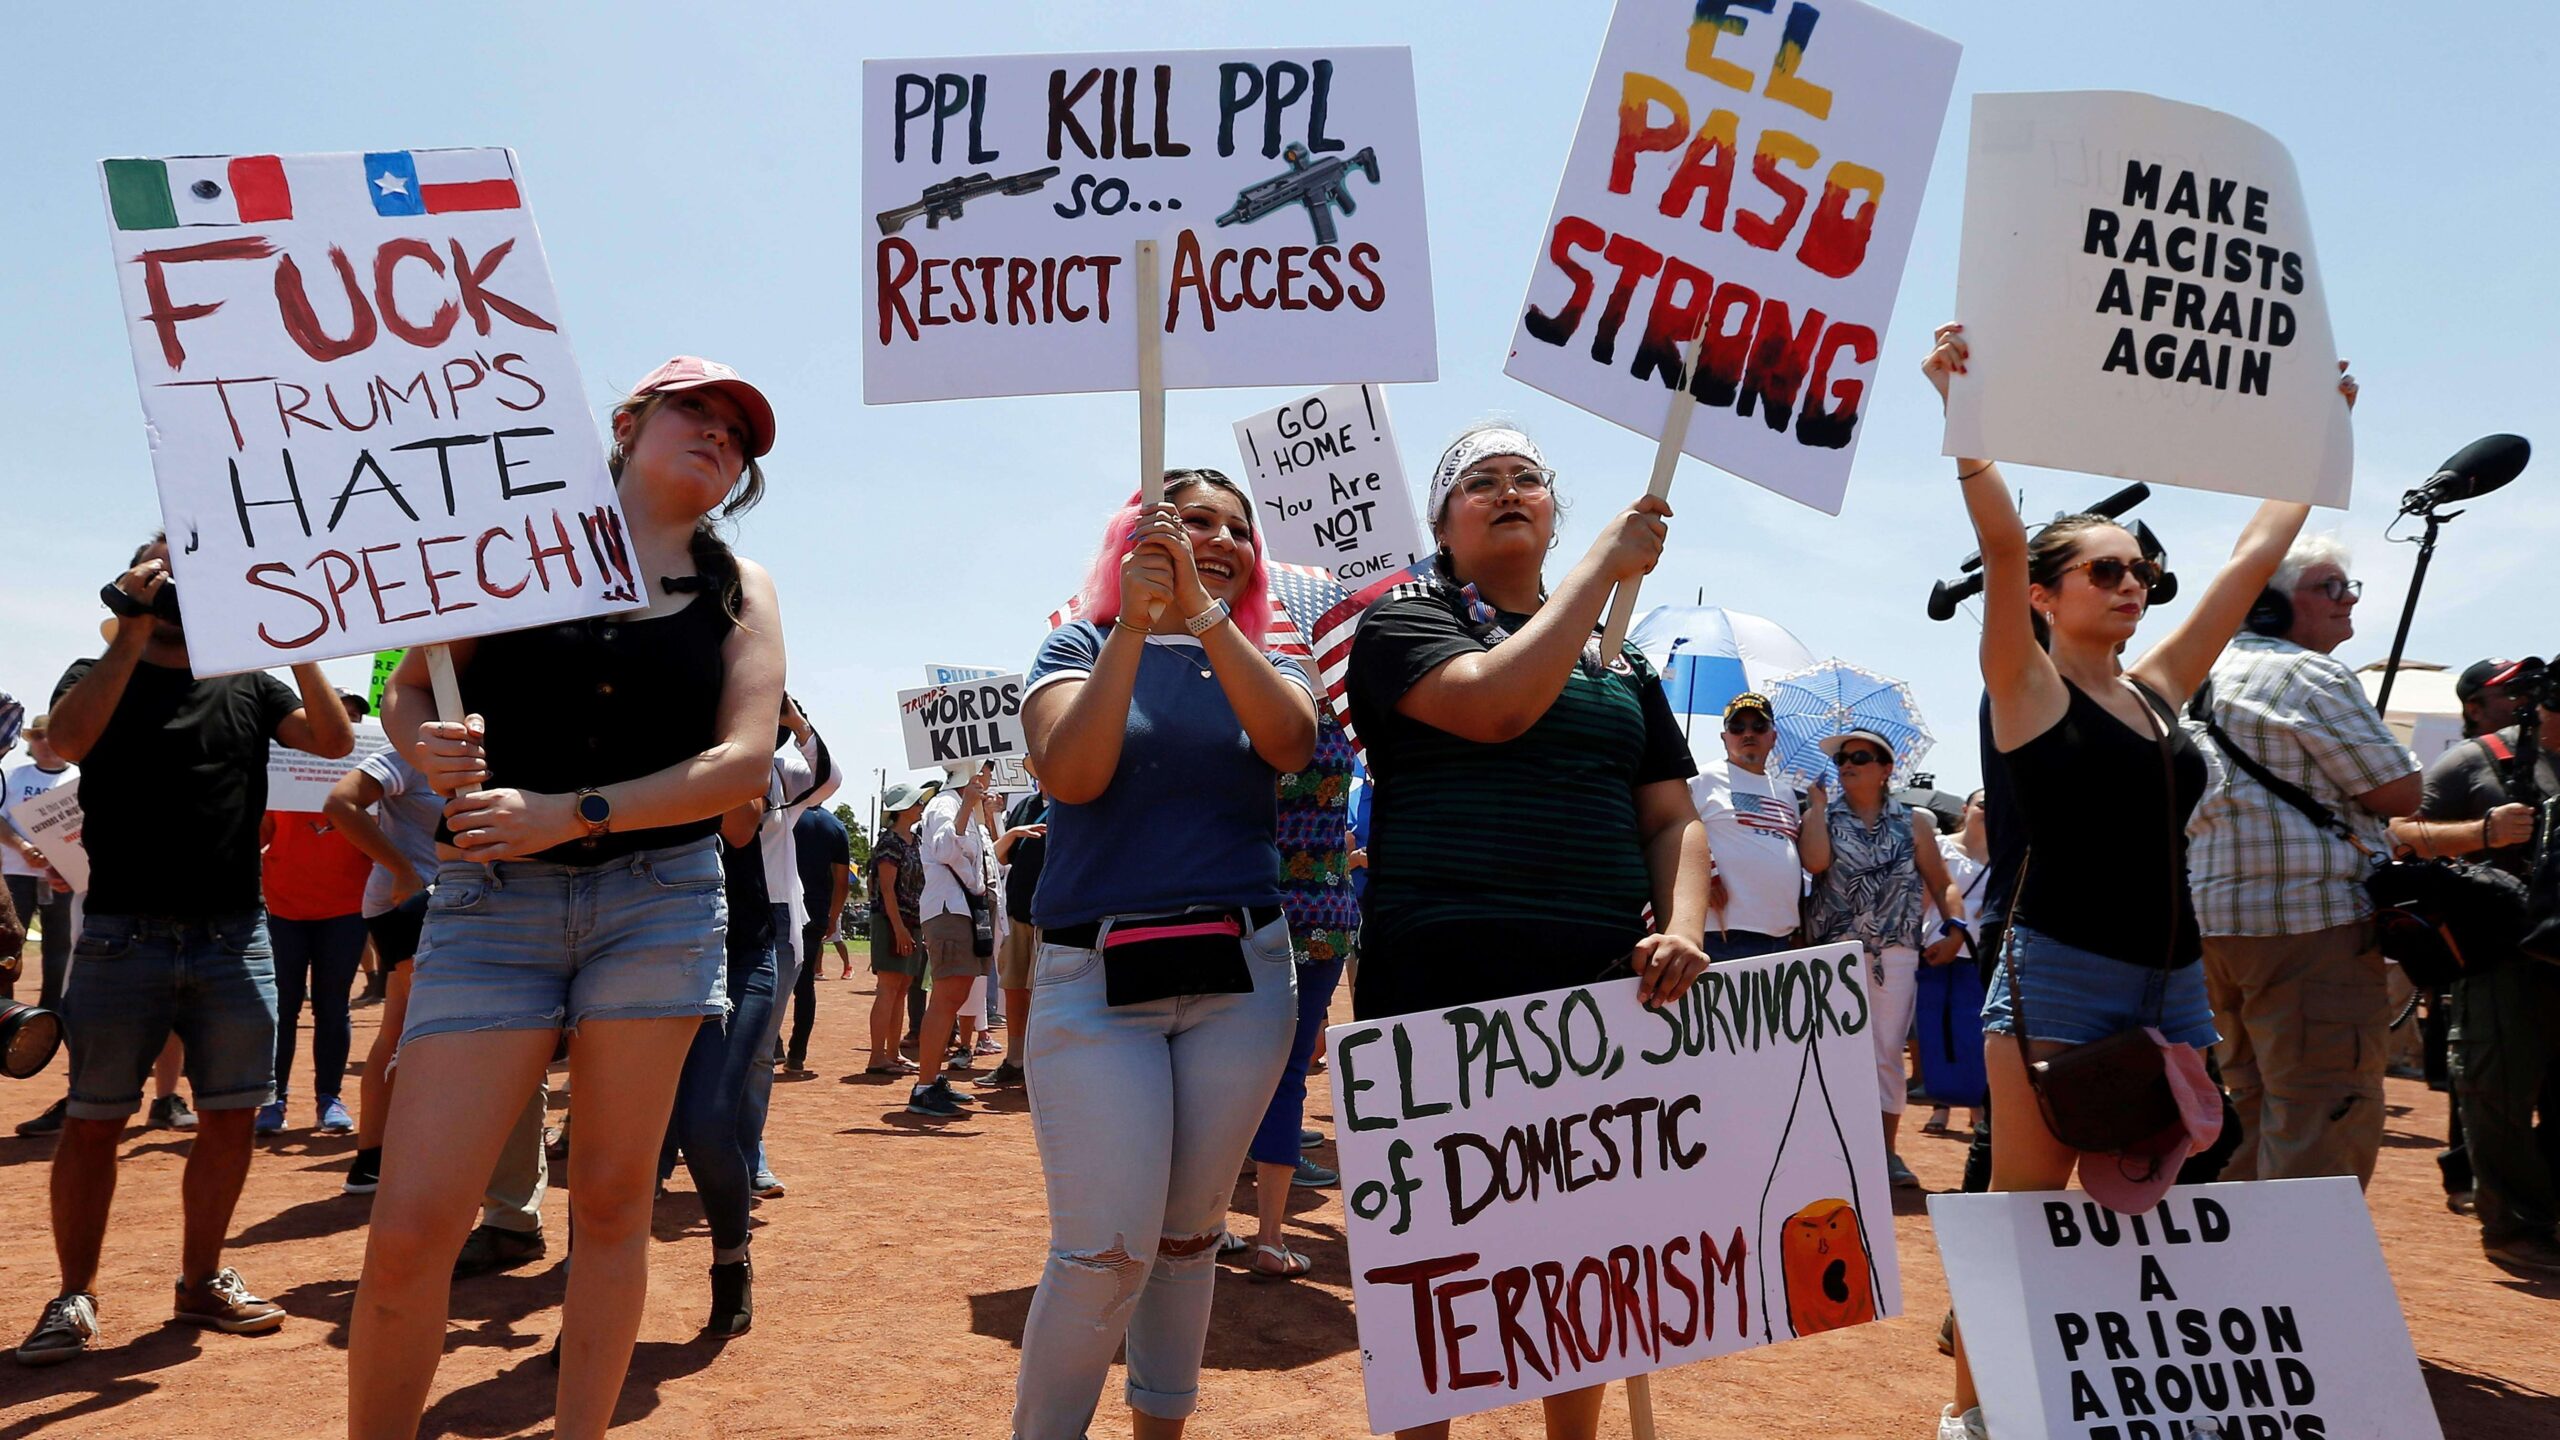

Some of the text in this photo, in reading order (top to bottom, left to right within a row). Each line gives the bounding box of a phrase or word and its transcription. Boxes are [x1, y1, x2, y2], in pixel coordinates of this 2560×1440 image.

[1685, 0, 1833, 120] EL
[894, 59, 1345, 164] PPL KILL PPL
[1607, 71, 1885, 279] PASO
[2122, 159, 2269, 235] MAKE
[877, 228, 1386, 346] RESTRICT ACCESS
[2083, 207, 2305, 296] RACISTS
[129, 235, 558, 372] FUCK
[1524, 215, 1878, 450] STRONG
[2096, 267, 2297, 348] AFRAID
[155, 350, 546, 452] TRUMP'S
[2102, 327, 2272, 397] AGAIN
[1273, 423, 1357, 477] HOME
[1277, 397, 1328, 440] GO
[228, 427, 567, 548] HATE
[1313, 501, 1376, 548] NOT
[1337, 552, 1395, 580] COME
[902, 685, 948, 715] TRUMP'S
[920, 683, 1021, 728] WORDS
[930, 721, 1012, 762] KILL
[1338, 952, 1869, 1132] EL PASO, SURVIVORS
[1350, 1094, 1707, 1235] of DOMESTIC
[2043, 1197, 2231, 1248] BUILD
[1364, 1225, 1748, 1395] TERRORISM
[2140, 1254, 2178, 1302] A
[2055, 1305, 2303, 1362] PRISON
[2070, 1357, 2316, 1421] AROUND
